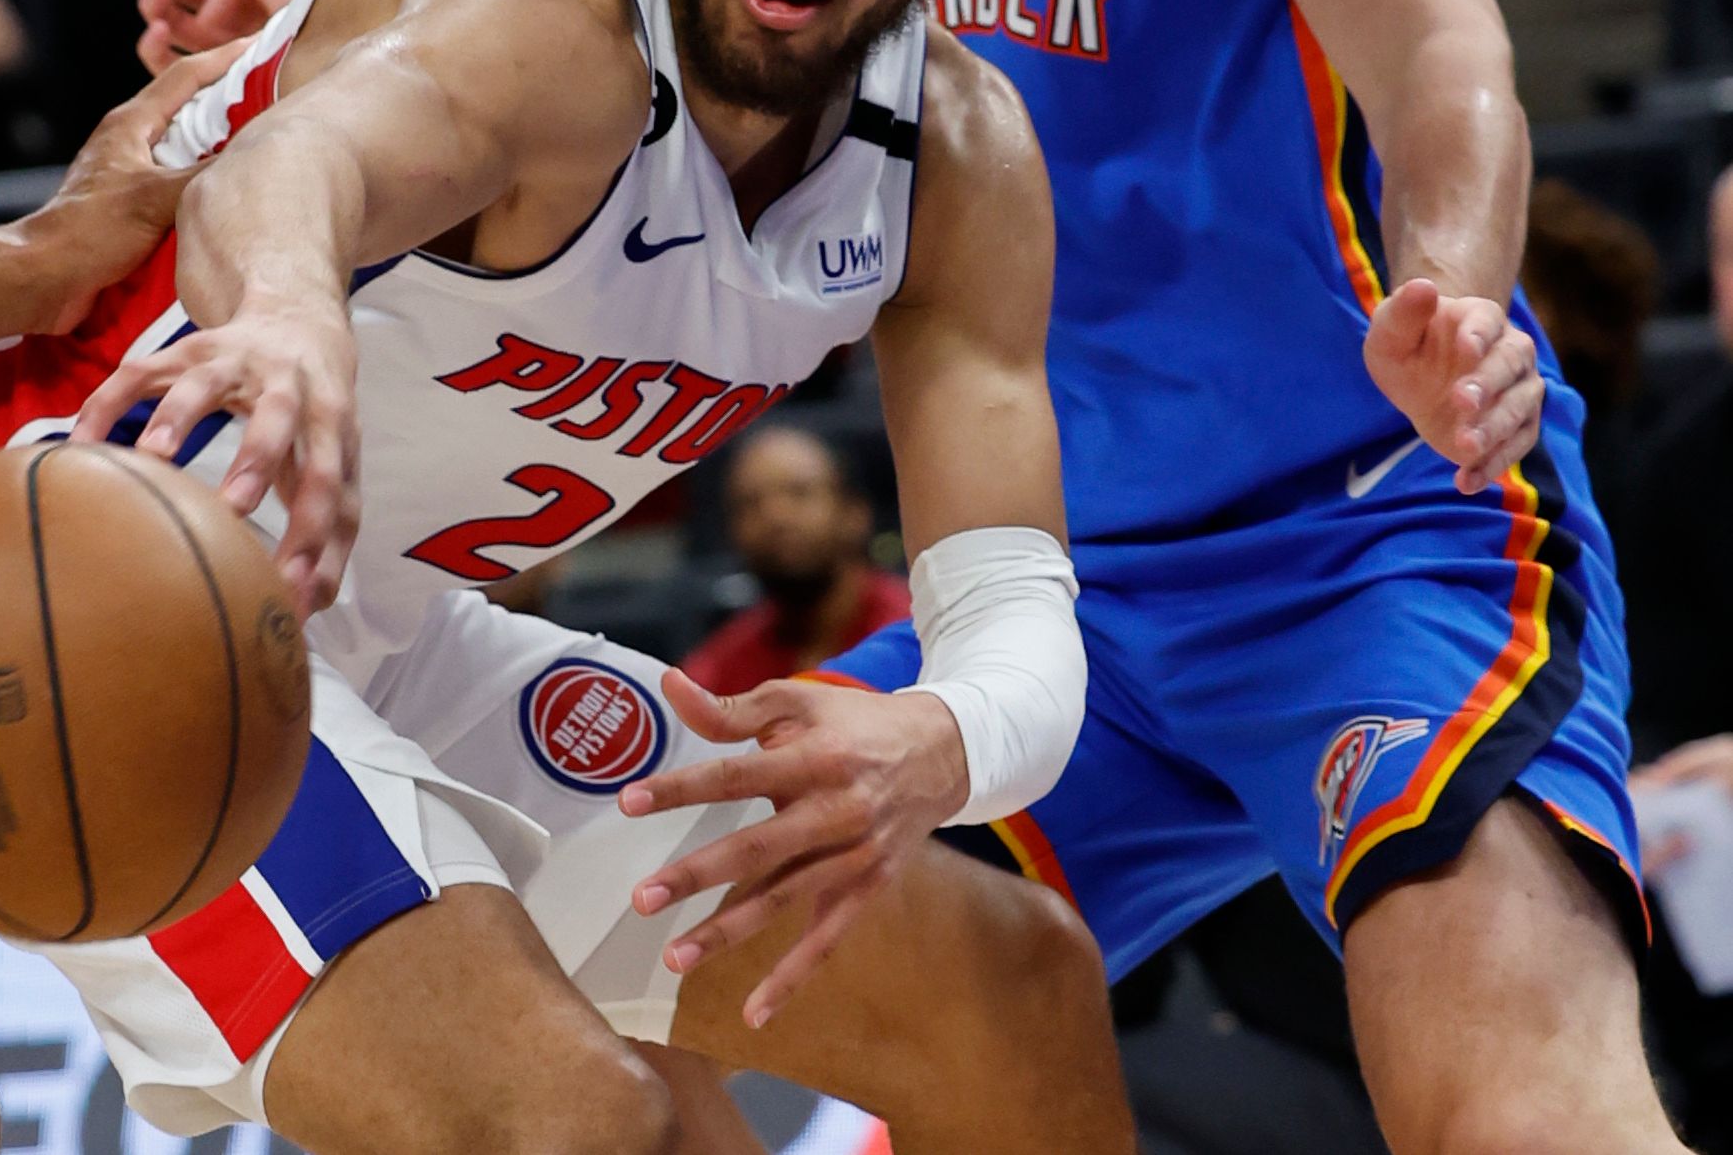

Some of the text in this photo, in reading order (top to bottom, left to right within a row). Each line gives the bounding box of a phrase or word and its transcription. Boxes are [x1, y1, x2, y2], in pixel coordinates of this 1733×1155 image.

[819, 234, 882, 278] UWM
[403, 464, 615, 581] 2
[551, 680, 611, 749] DETROIT
[570, 694, 634, 767] PISTONS
